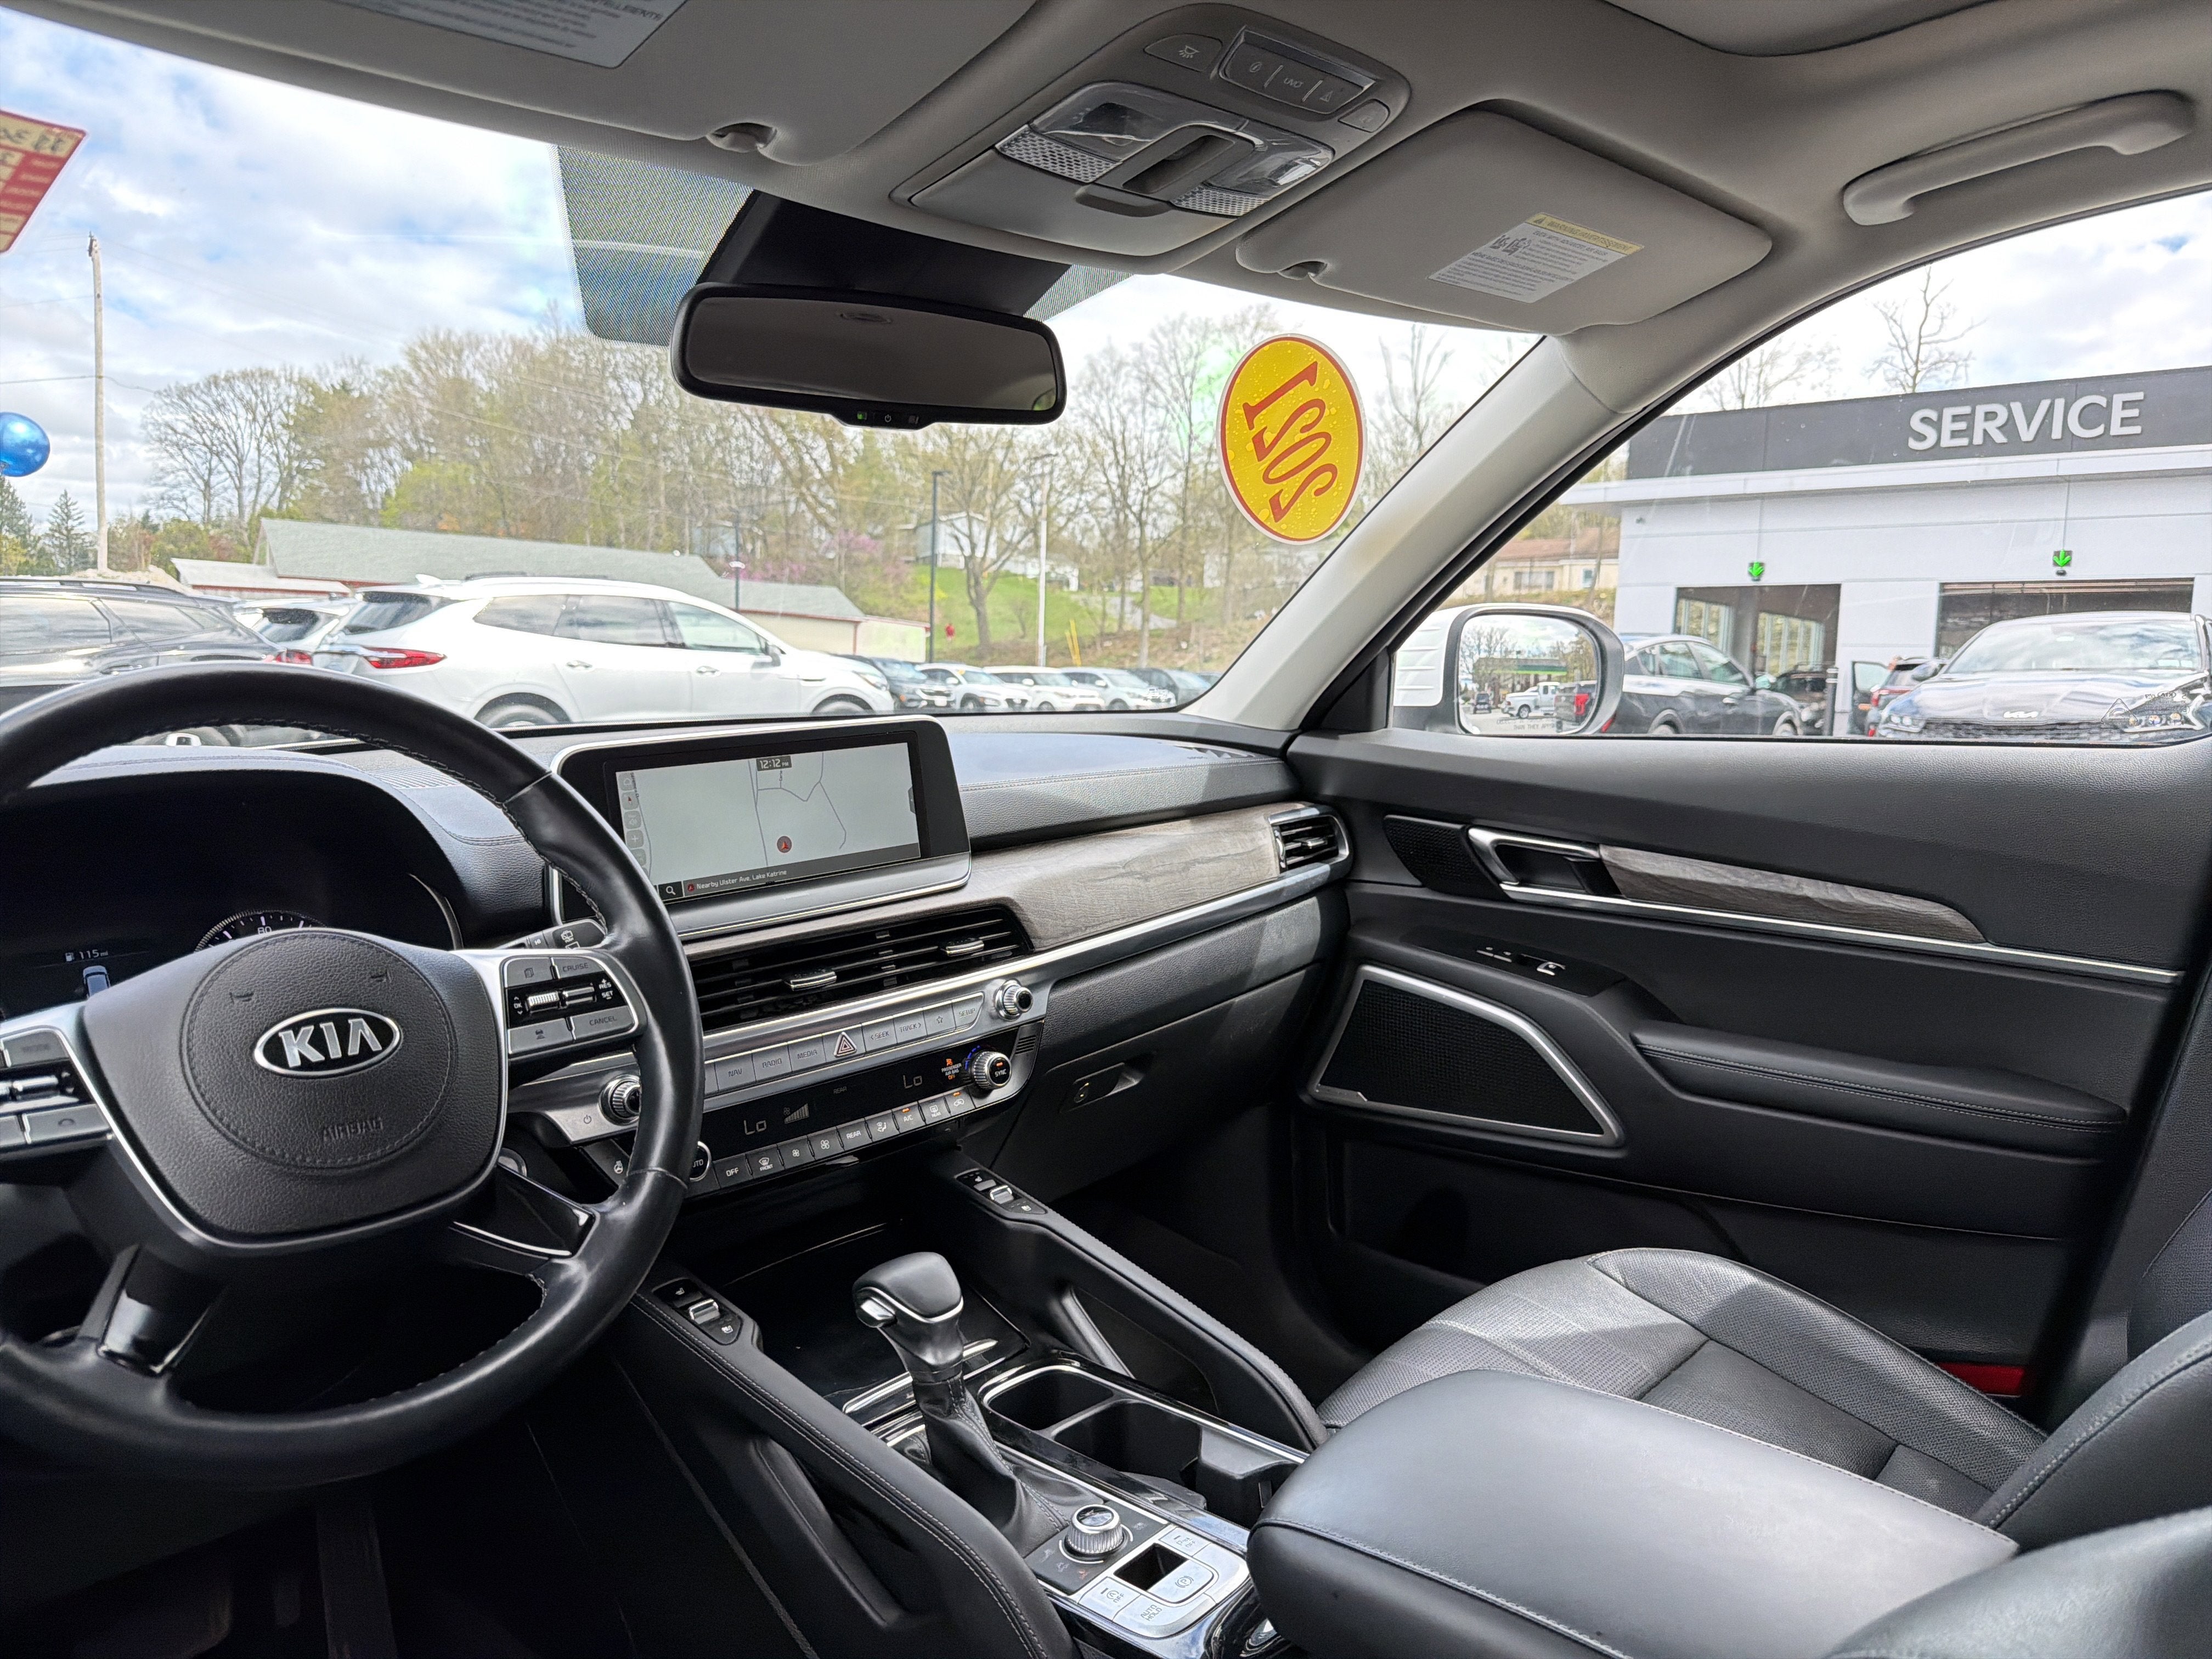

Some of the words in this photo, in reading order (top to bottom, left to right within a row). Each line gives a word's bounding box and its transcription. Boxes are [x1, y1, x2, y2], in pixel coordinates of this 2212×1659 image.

[1908, 391, 2144, 450] SERVICE
[759, 759, 781, 769] 12:12
[697, 881, 719, 889] Nearby
[766, 870, 787, 878] Katrine
[80, 950, 99, 960] 115
[562, 962, 589, 972] CRUISE
[958, 1008, 975, 1017] SETUP
[589, 1015, 617, 1026] CANCEL
[279, 1018, 382, 1068] KIA
[797, 1049, 817, 1059] MEDIA
[762, 1058, 782, 1068] RADIO
[941, 1063, 962, 1073] PASSENGER
[728, 1069, 742, 1077] NAV
[995, 1069, 1007, 1077] SYNC
[903, 1075, 923, 1089] Lo
[743, 1120, 767, 1135] Lo
[847, 1130, 862, 1139] REAR
[692, 1159, 704, 1168] UTO
[726, 1167, 739, 1177] OFF
[1113, 1593, 1125, 1603] OFF
[1141, 1604, 1157, 1618] AUTO
[1145, 1607, 1163, 1621] HOLD
